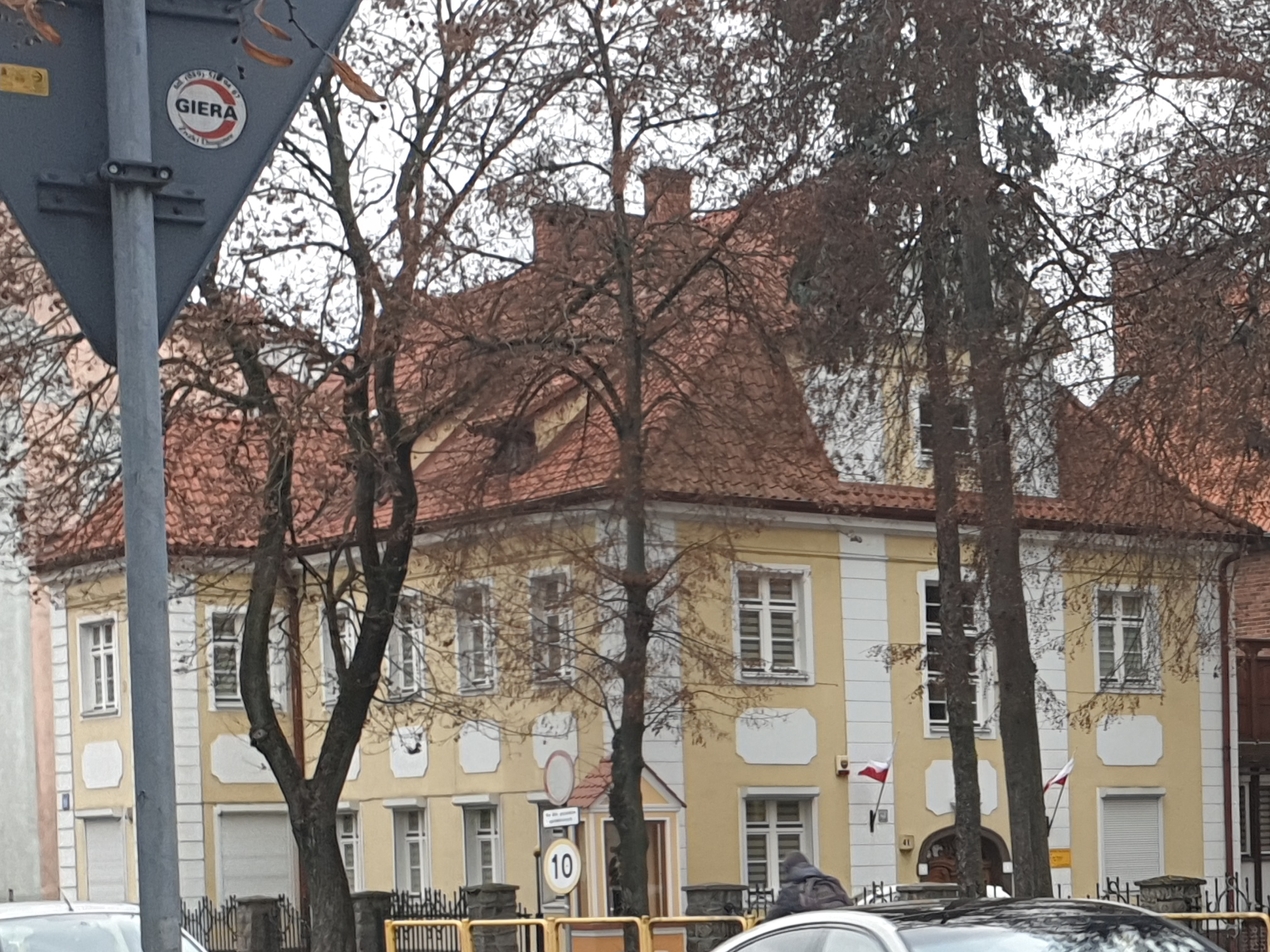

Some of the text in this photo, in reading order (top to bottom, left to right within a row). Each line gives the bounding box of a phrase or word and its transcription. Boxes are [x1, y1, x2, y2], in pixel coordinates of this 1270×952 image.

[175, 98, 238, 121] GIERA
[902, 838, 911, 846] 41
[551, 853, 573, 880] 10
